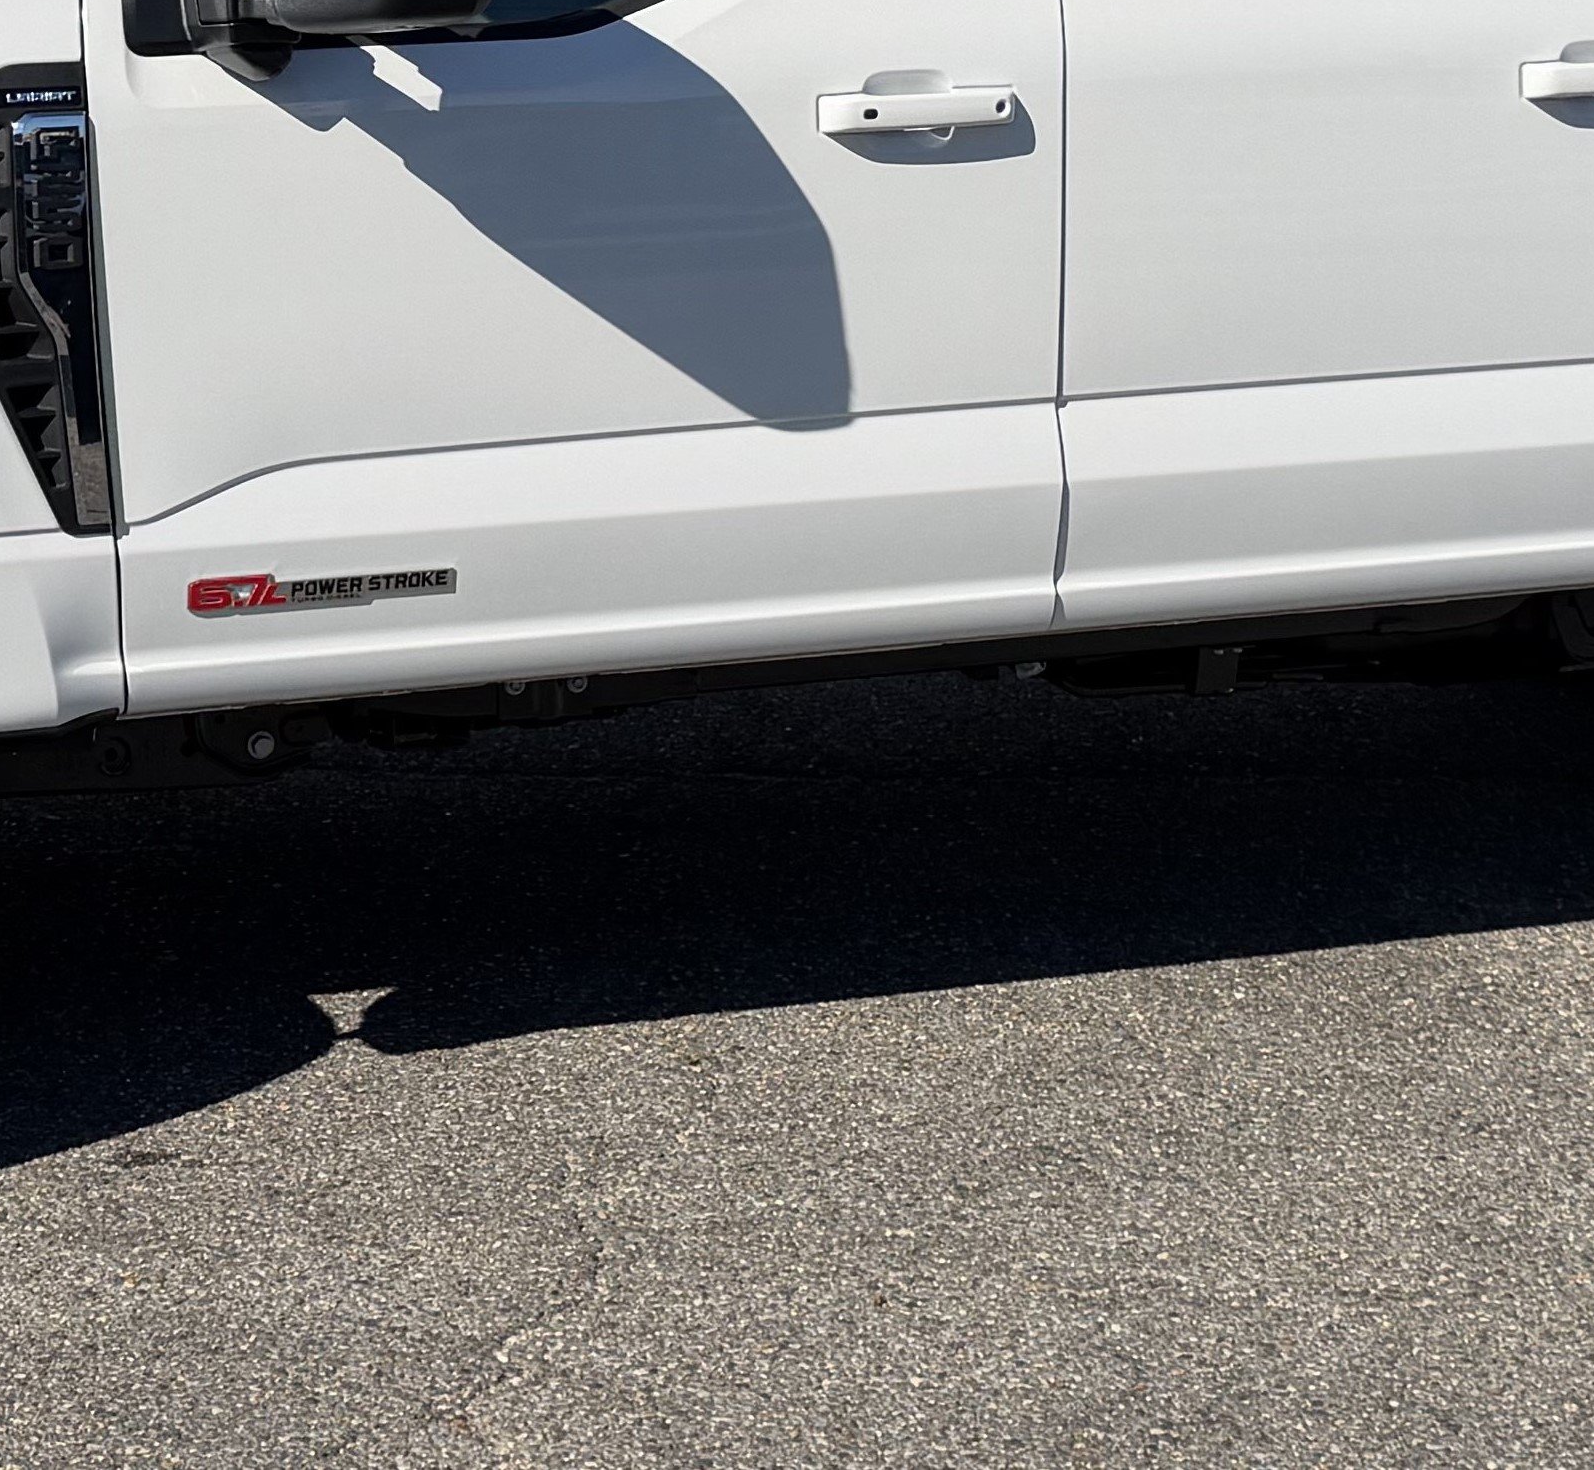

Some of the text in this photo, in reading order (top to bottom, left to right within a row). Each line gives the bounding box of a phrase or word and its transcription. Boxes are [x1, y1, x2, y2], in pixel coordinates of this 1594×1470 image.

[187, 568, 450, 613] 6.7L POWER STROKE
